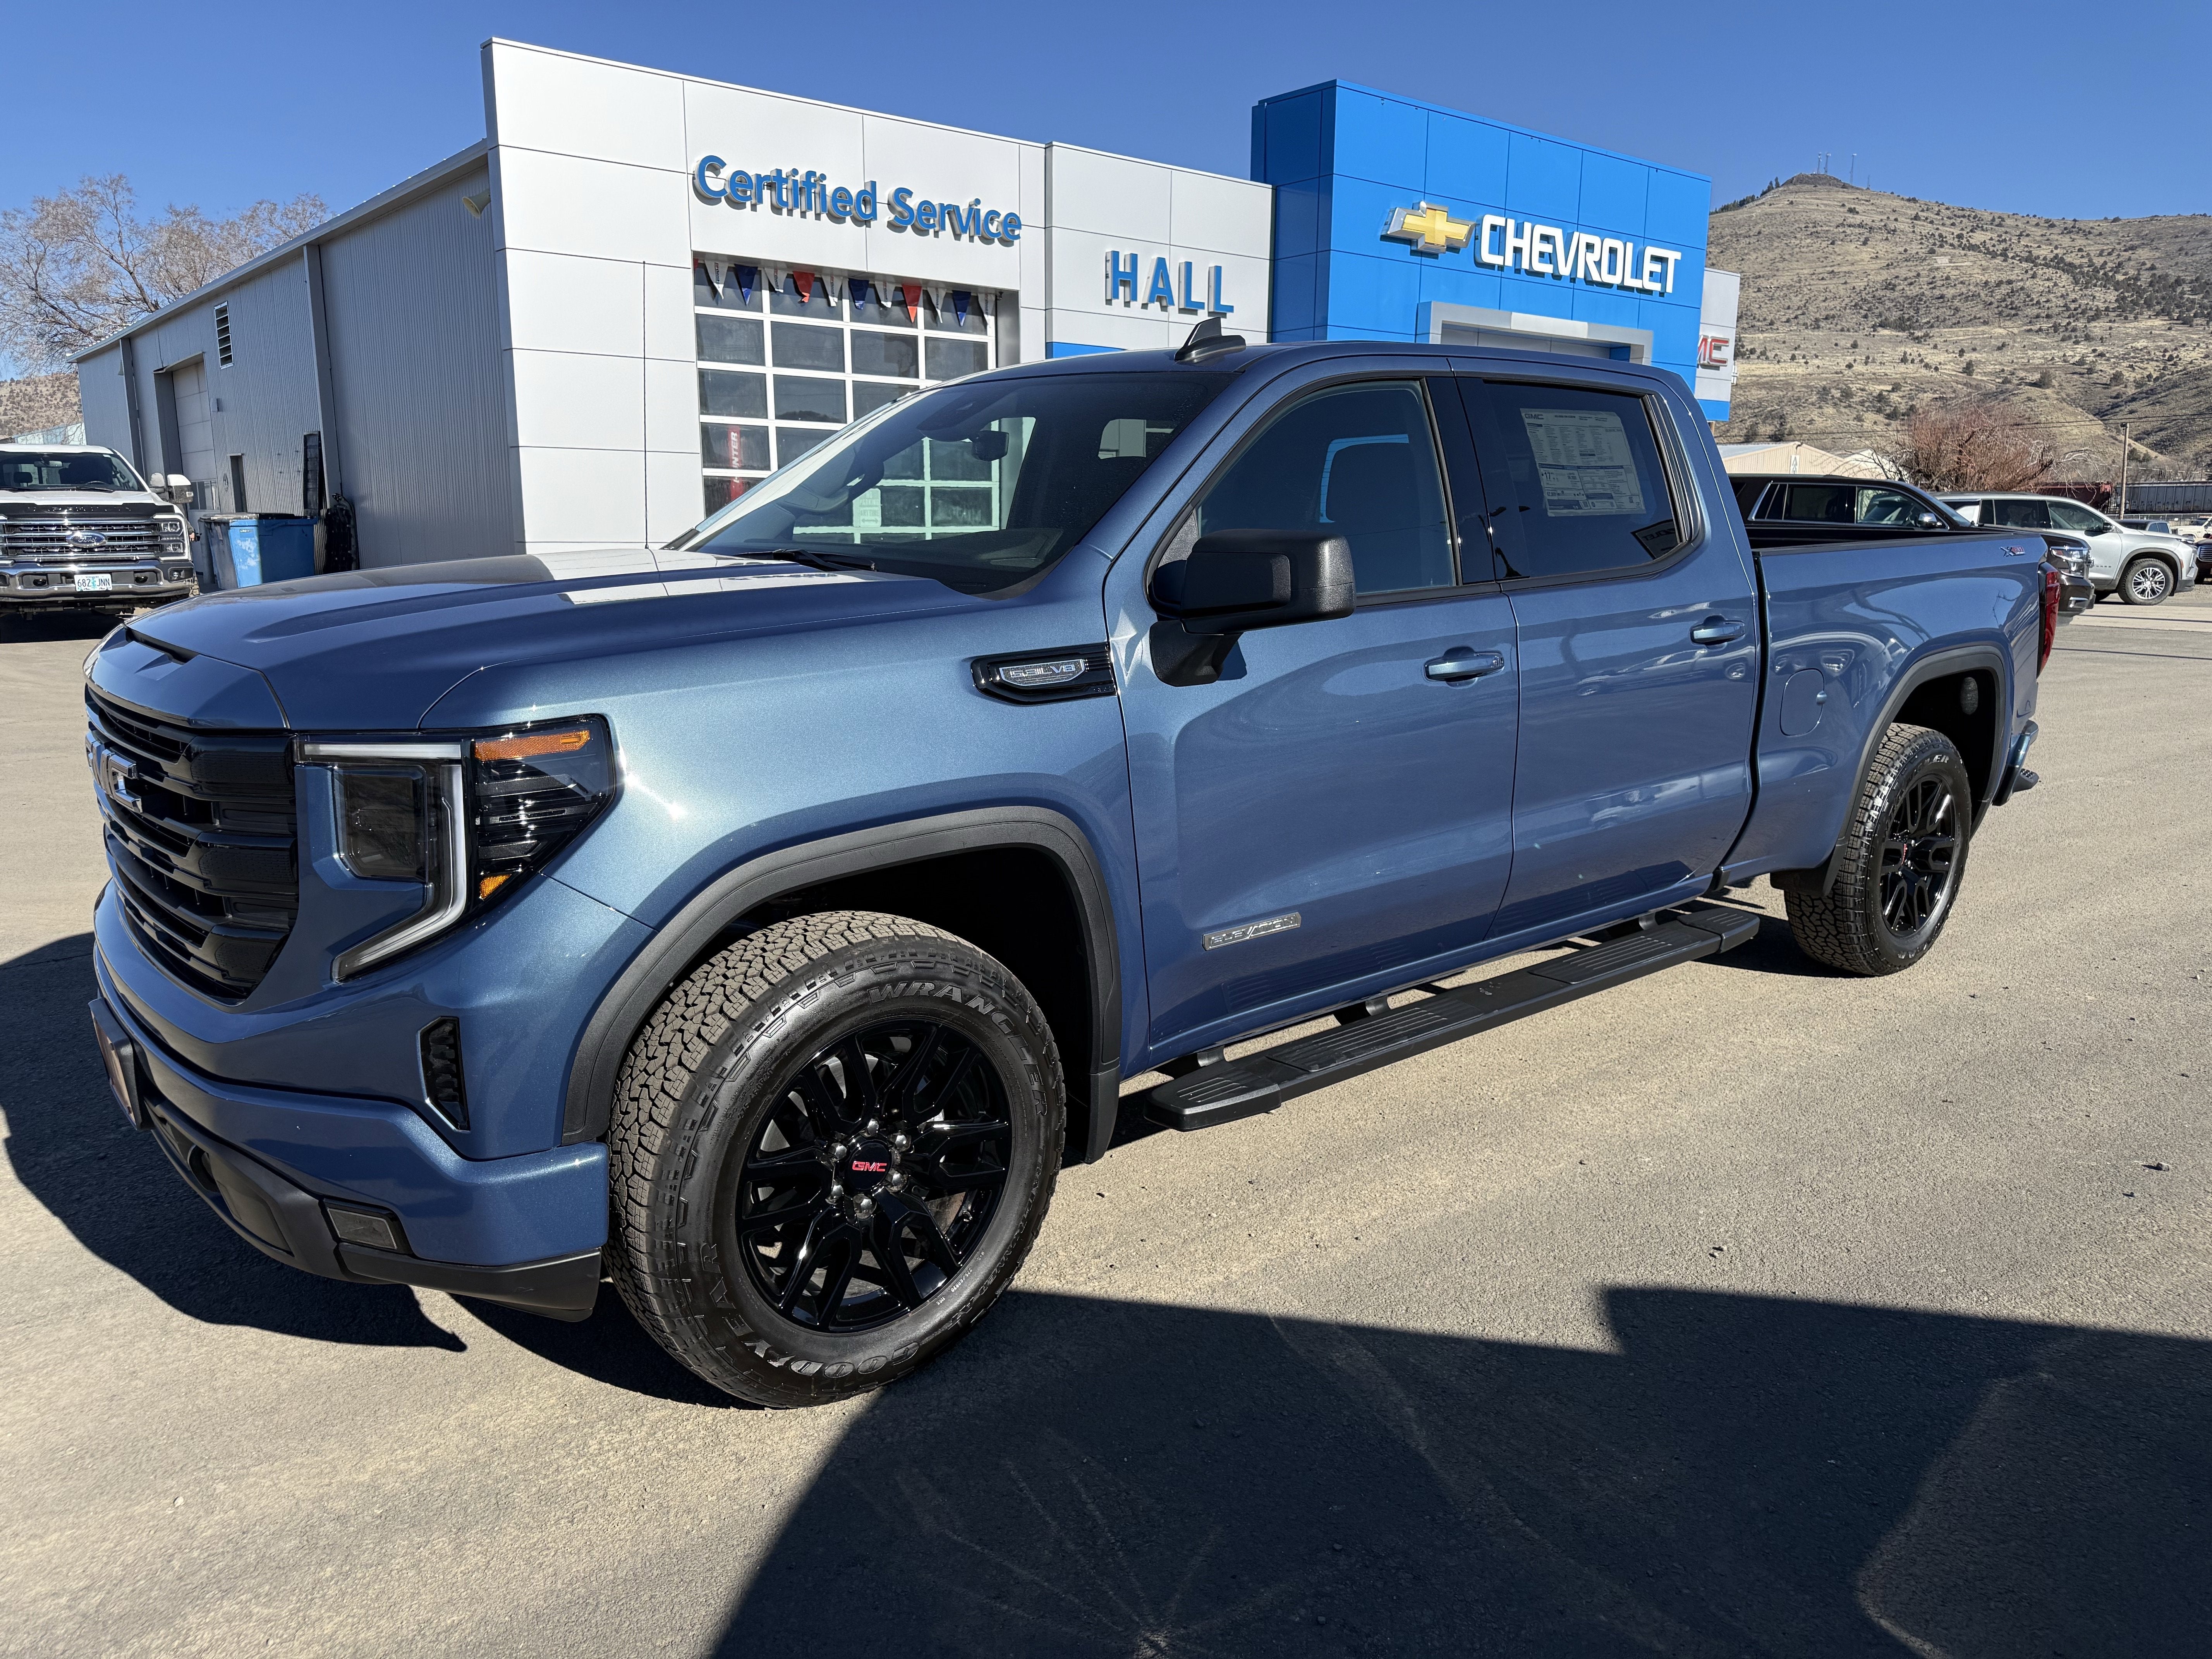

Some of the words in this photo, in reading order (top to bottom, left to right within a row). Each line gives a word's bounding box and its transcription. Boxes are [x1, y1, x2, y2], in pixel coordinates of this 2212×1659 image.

[696, 155, 877, 221] Certified
[890, 187, 1022, 241] Service
[1479, 214, 1681, 293] CHEVROLET
[1107, 250, 1234, 313] HALL
[1697, 335, 1729, 366] MC
[78, 579, 91, 587] 682
[97, 578, 110, 586] JNN
[1050, 664, 1075, 673] V8
[867, 980, 1048, 1117] WRANGLER
[738, 1068, 774, 1119] 275/60R20
[852, 1161, 887, 1171] GMC
[950, 1267, 973, 1293] 275/60R20
[700, 1240, 920, 1378] GOODYEAR
